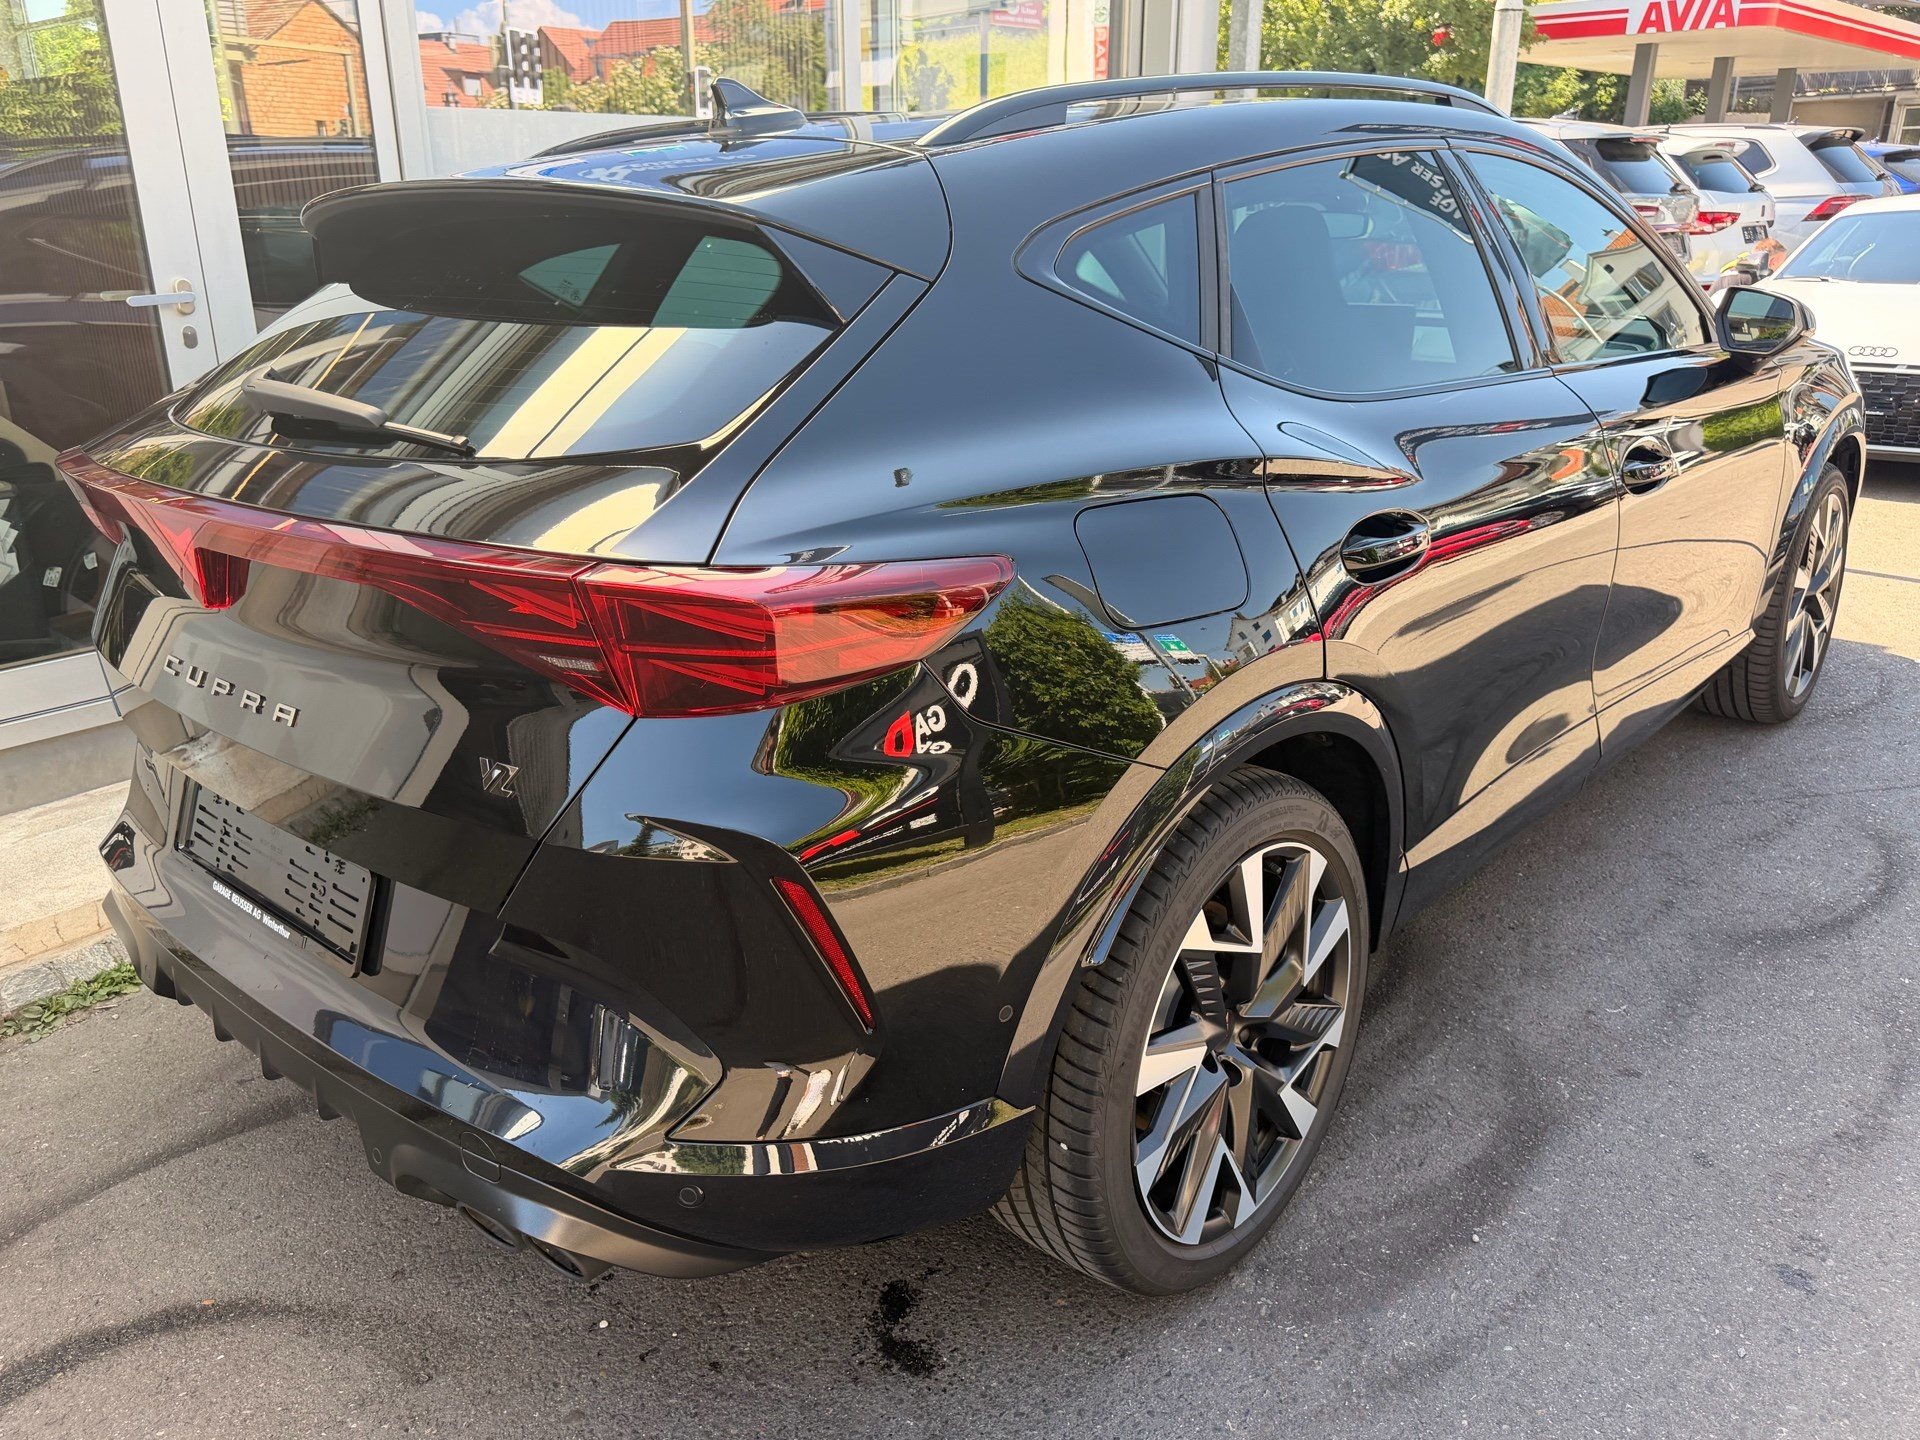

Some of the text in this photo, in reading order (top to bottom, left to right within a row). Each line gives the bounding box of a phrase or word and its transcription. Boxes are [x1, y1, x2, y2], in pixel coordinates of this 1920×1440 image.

[1637, 0, 1736, 34] AVIA
[163, 654, 300, 728] CUPRA
[479, 756, 519, 798] VZ
[212, 880, 291, 940] GARAGE REUSSER AG Winterthur
